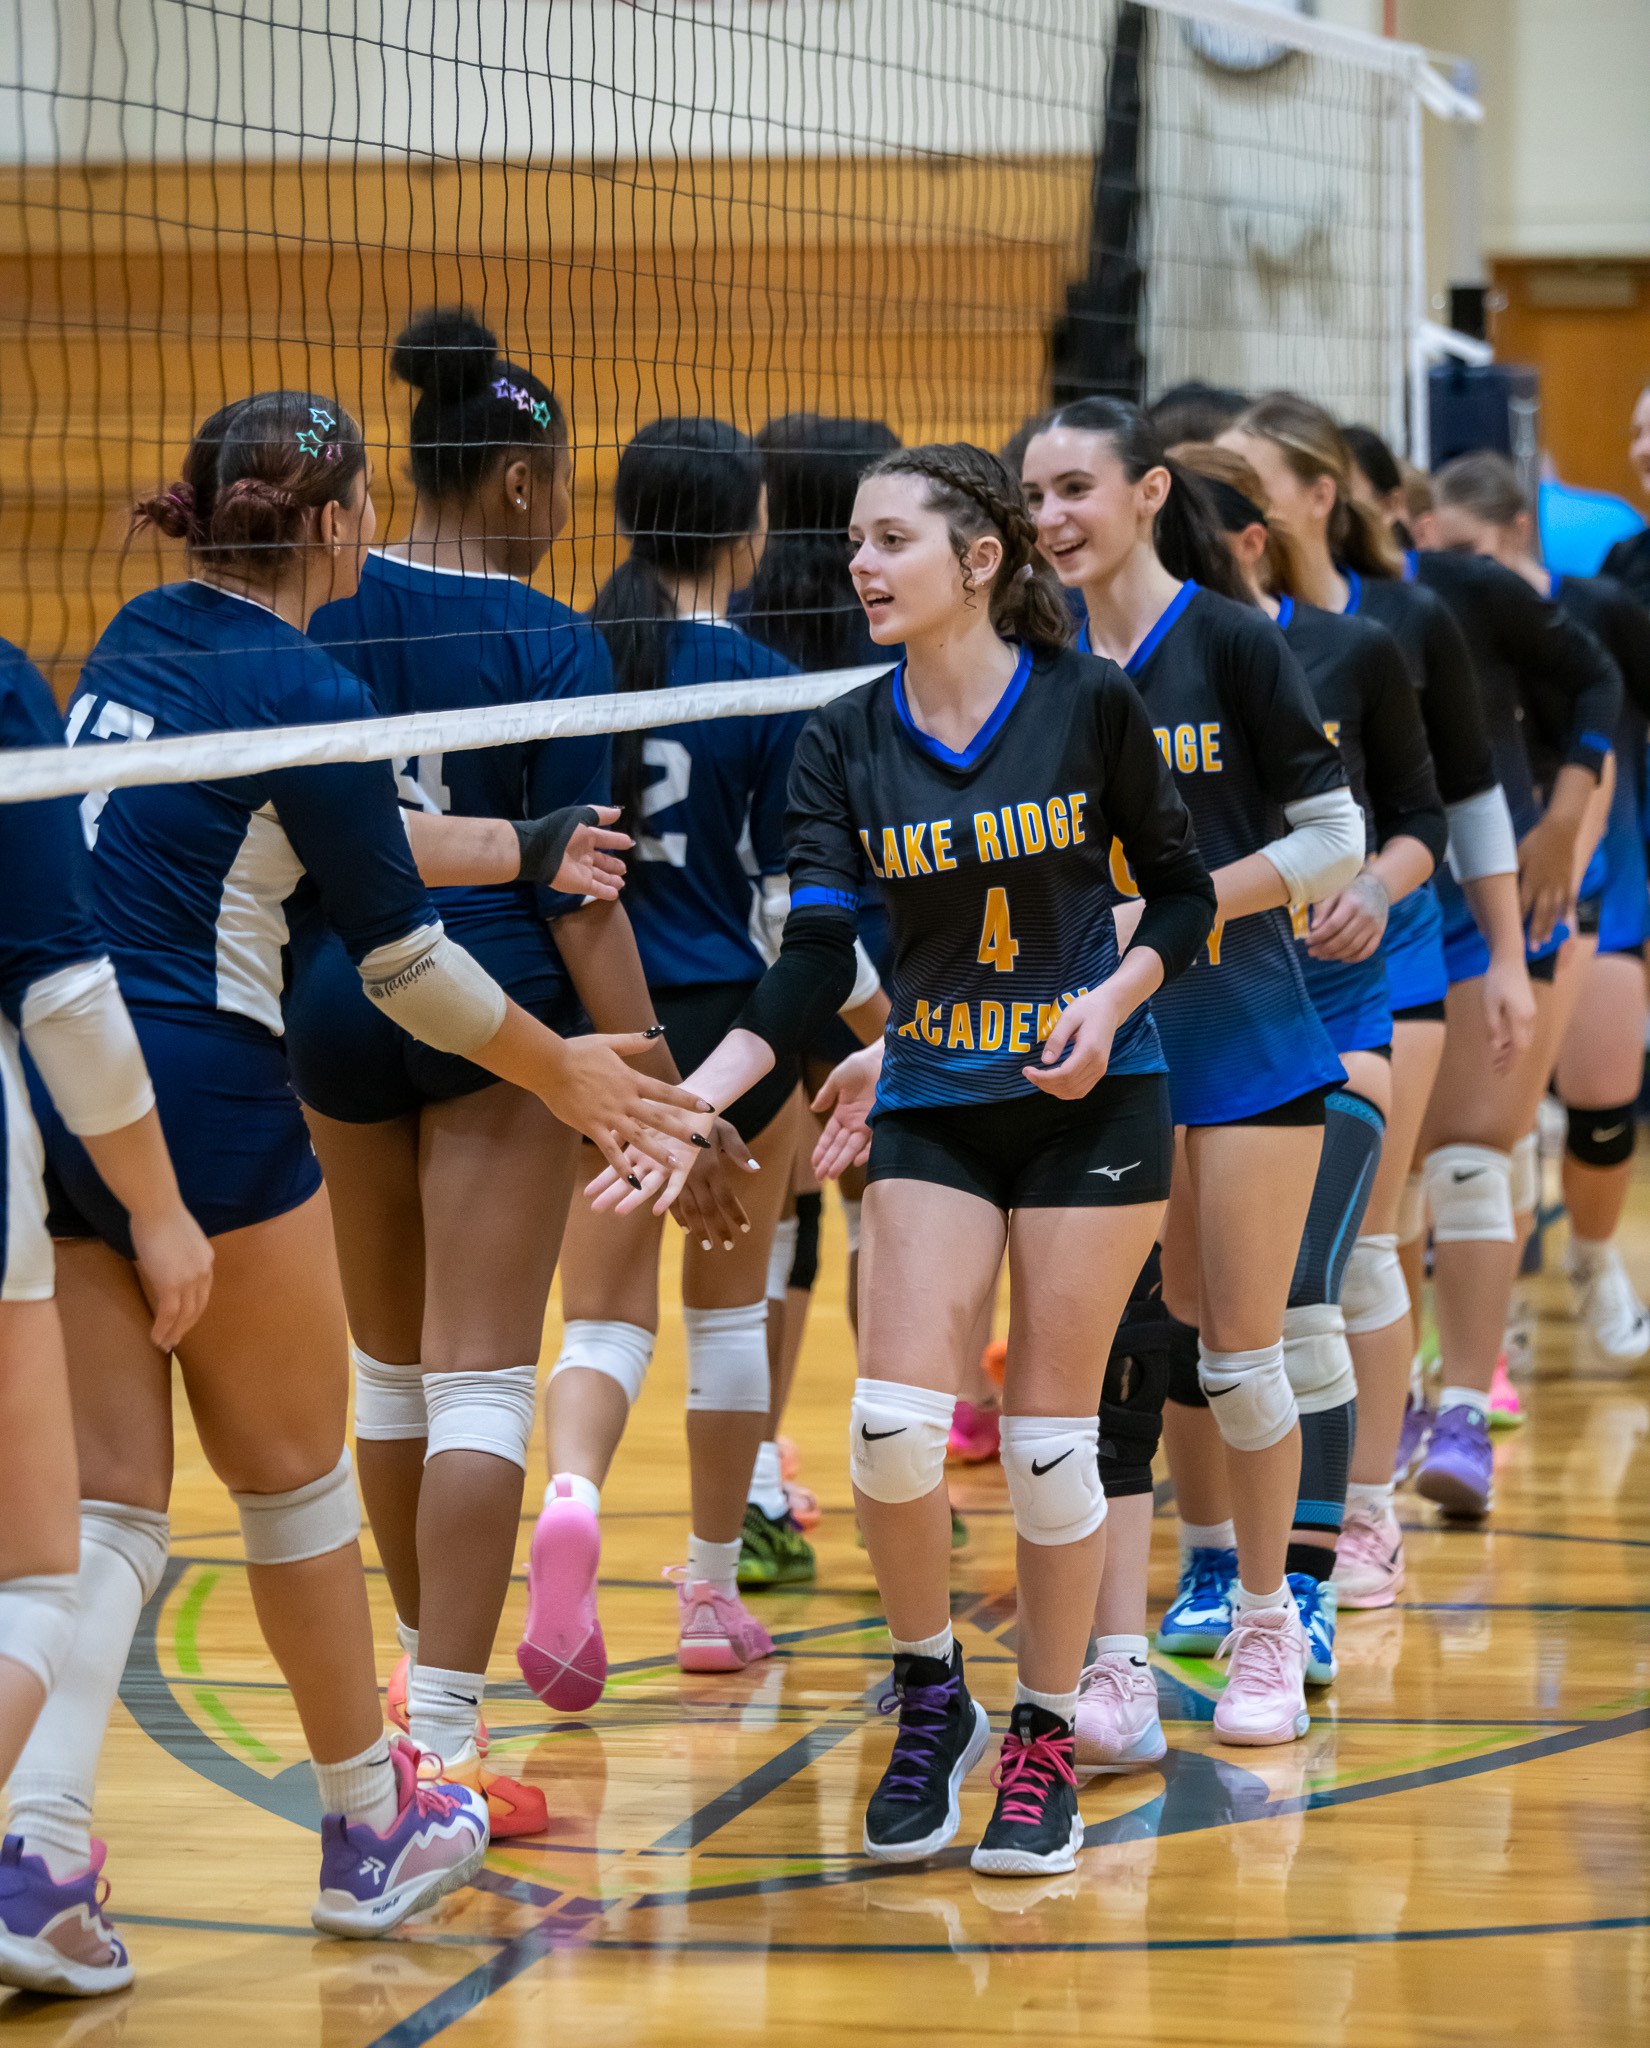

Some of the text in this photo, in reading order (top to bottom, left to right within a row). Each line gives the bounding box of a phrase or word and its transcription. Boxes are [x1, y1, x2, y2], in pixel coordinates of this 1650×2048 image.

[640, 737, 692, 868] 2
[859, 793, 1086, 878] LAKE RIDGE
[977, 887, 1019, 972] 4
